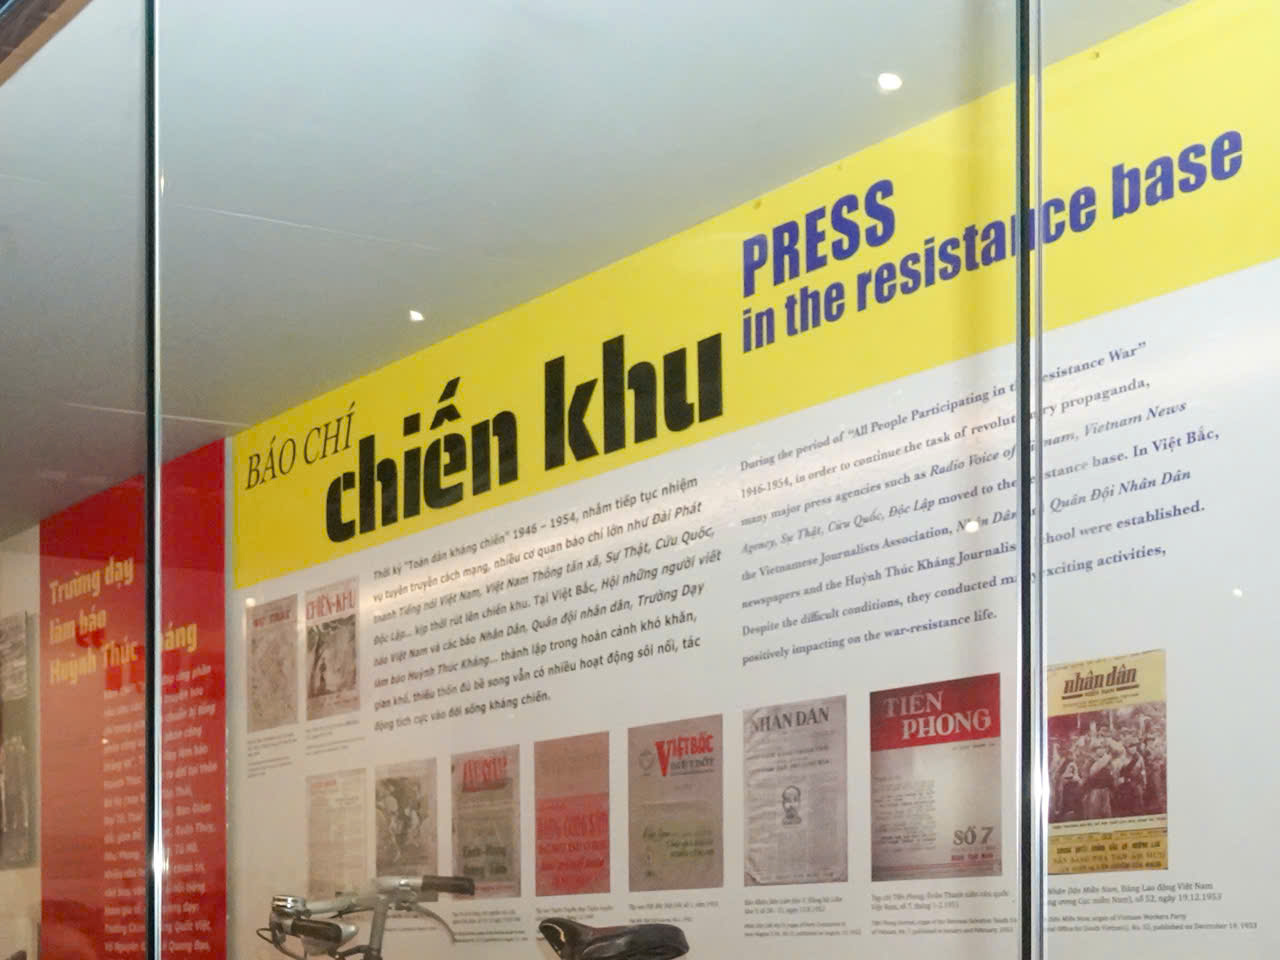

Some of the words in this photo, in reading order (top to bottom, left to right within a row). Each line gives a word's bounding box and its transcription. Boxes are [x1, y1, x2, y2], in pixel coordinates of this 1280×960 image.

[742, 179, 896, 299] PRESS
[742, 307, 775, 355] in
[784, 280, 846, 338] the
[1112, 130, 1243, 220] base
[325, 376, 519, 543] chiến
[544, 332, 724, 472] khu
[741, 456, 776, 472] During
[778, 449, 794, 460] the
[796, 436, 831, 458] period
[833, 431, 845, 444] of
[871, 414, 908, 432] People
[912, 392, 990, 421] Participating
[993, 386, 1006, 397] in
[1042, 358, 1106, 382] esistance
[796, 474, 806, 483] in
[808, 466, 837, 480] order
[840, 462, 851, 471] to
[854, 448, 902, 467] continue
[904, 441, 923, 453] the
[926, 432, 951, 447] task
[954, 426, 968, 439] of
[1061, 378, 1151, 414] propaganda,
[245, 434, 297, 491] BÁO
[303, 400, 356, 465] CHÍ
[741, 514, 768, 526] many
[771, 504, 801, 518] major
[804, 496, 833, 512] press
[835, 483, 882, 503] agencies
[885, 473, 911, 488] such
[914, 472, 926, 480] as
[930, 459, 966, 476] Radio
[969, 452, 1000, 466] Voice
[1003, 447, 1017, 460] of
[1084, 414, 1143, 436] Vietnam
[1146, 403, 1188, 420] News
[889, 504, 911, 517] Độc
[914, 498, 936, 512] Lập
[938, 486, 979, 505] moved
[982, 485, 993, 495] to
[997, 479, 1018, 491] the
[1093, 453, 1129, 467] base.
[1133, 445, 1149, 457] In
[1152, 437, 1183, 452] Việt
[1187, 426, 1220, 444] Bắc,
[616, 494, 637, 509] tiếp
[640, 489, 658, 503] tục
[662, 478, 699, 496] nhiệm
[652, 509, 672, 525] Đài
[674, 502, 703, 518] Phát
[742, 571, 757, 581] the
[760, 558, 819, 576] Vietnamese
[820, 544, 880, 567] Journalists
[882, 527, 954, 548] Association,
[1050, 494, 1087, 512] Quân
[1091, 484, 1115, 501] Đội
[1119, 478, 1157, 494] Nhân
[1161, 470, 1192, 485] Dân
[742, 591, 801, 608] newspapers
[804, 582, 824, 595] and
[826, 580, 843, 590] the
[846, 570, 882, 586] Huỳnh
[885, 564, 914, 577] Thúc
[917, 557, 956, 571] Kháng
[956, 542, 1018, 566] Journalis
[1080, 523, 1113, 535] were
[1117, 500, 1206, 528] established.
[49, 569, 101, 605] Trường
[104, 555, 135, 589] dạy
[534, 592, 550, 606] Tại
[552, 587, 573, 601] Việt
[623, 568, 659, 584] những
[661, 556, 696, 575] người
[580, 604, 607, 619] nhân
[638, 589, 678, 606] Trường
[682, 584, 705, 596] Dạy
[742, 621, 780, 636] Despite
[783, 617, 798, 628] the
[801, 608, 840, 624] difficult
[842, 599, 904, 616] conditions,
[907, 592, 931, 604] they
[934, 576, 997, 598] conducted
[1046, 560, 1094, 576] xciting
[1097, 546, 1167, 566] activities,
[79, 605, 107, 635] báo
[550, 637, 578, 651] trong
[742, 647, 790, 666] positively
[792, 638, 845, 655] impacting
[848, 636, 862, 644] on
[864, 630, 882, 642] the
[884, 616, 971, 637] war-resistance
[975, 609, 998, 622] life.
[533, 666, 545, 678] có
[548, 661, 577, 675] nhiều
[580, 656, 604, 669] hoạt
[607, 651, 634, 664] động
[638, 644, 654, 658] sôi
[683, 636, 701, 649] tác
[1063, 671, 1106, 694] nhân
[1106, 663, 1138, 687] dân
[901, 708, 992, 740] PHONG
[952, 825, 977, 845] SỐ
[980, 826, 995, 845] 7
